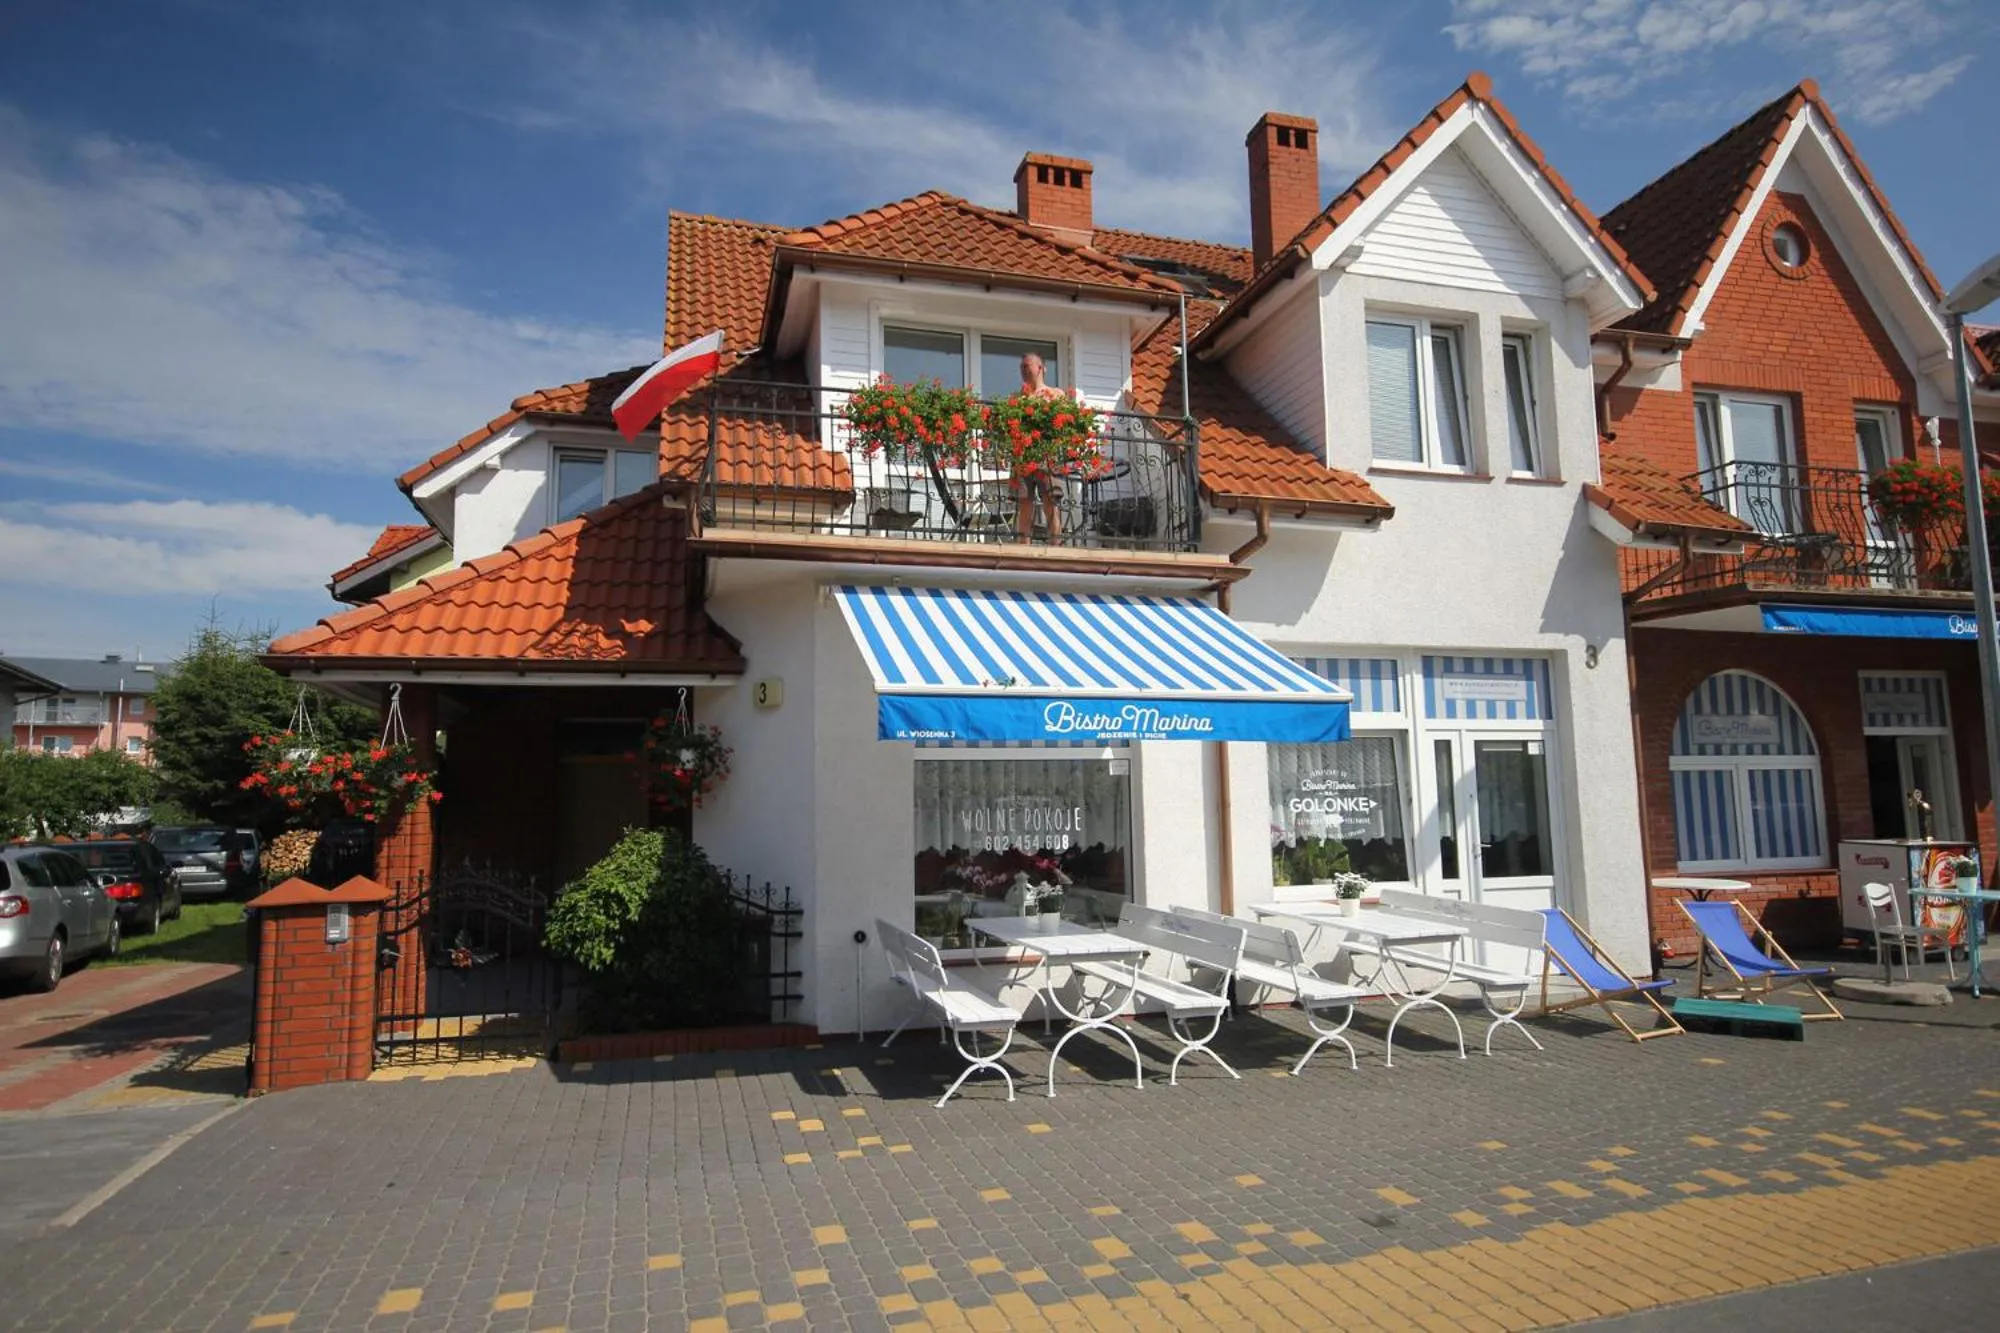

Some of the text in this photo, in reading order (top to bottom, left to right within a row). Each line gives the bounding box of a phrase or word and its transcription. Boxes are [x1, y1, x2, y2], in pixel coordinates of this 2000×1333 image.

[1949, 615, 1978, 634] Bist
[1585, 645, 1598, 669] 3
[759, 682, 767, 704] 3
[1044, 701, 1213, 733] Bistro Marina
[961, 807, 1082, 832] WOLNE POKOJE
[985, 835, 1009, 851] 602
[1015, 834, 1040, 850] 454
